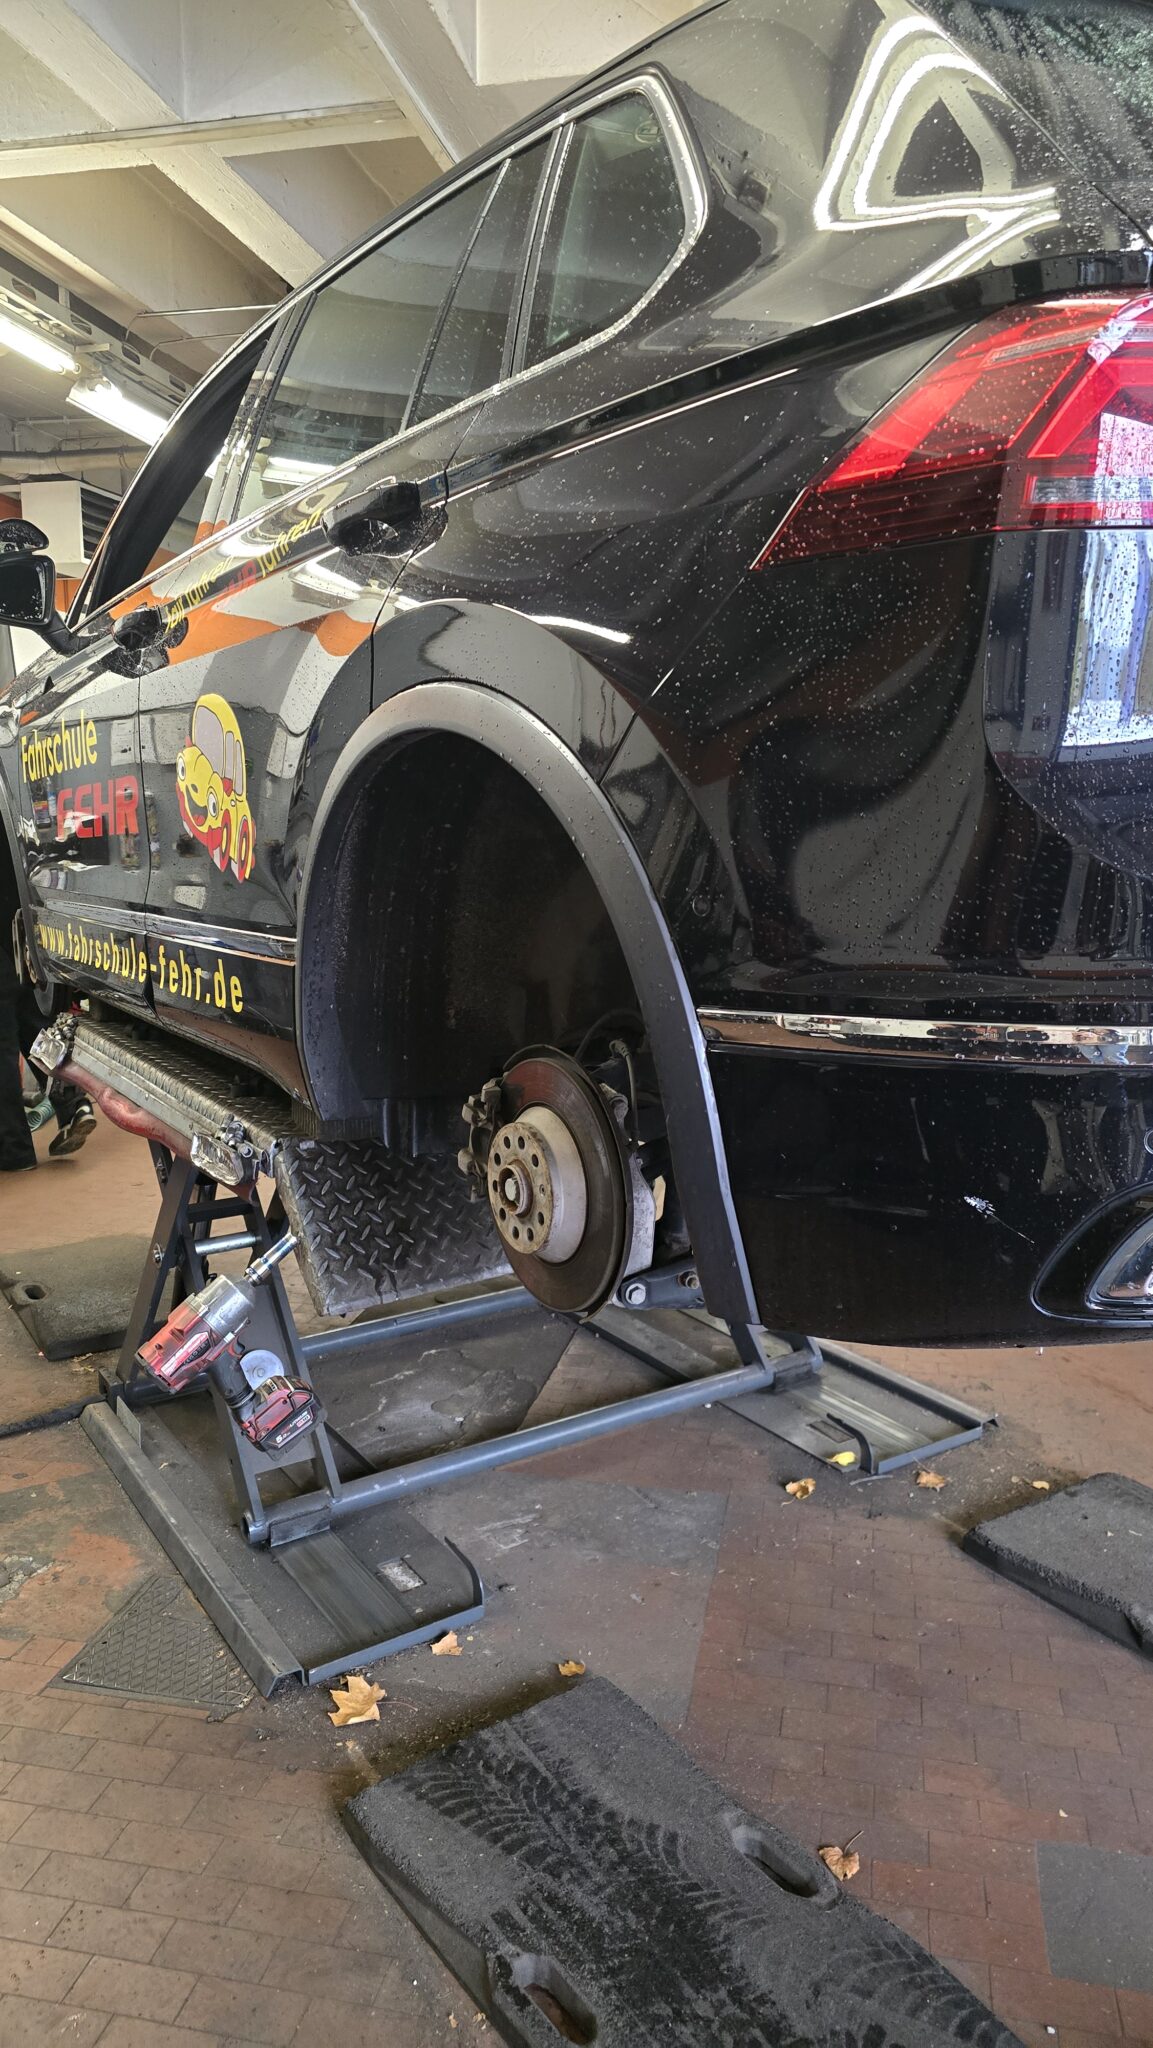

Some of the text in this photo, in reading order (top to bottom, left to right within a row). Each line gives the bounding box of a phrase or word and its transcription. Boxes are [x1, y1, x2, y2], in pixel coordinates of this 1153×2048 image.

[21, 708, 98, 784] Fahrschule
[56, 774, 140, 839] FEHR
[39, 922, 244, 1013] www.fahrschule-fehr.de
